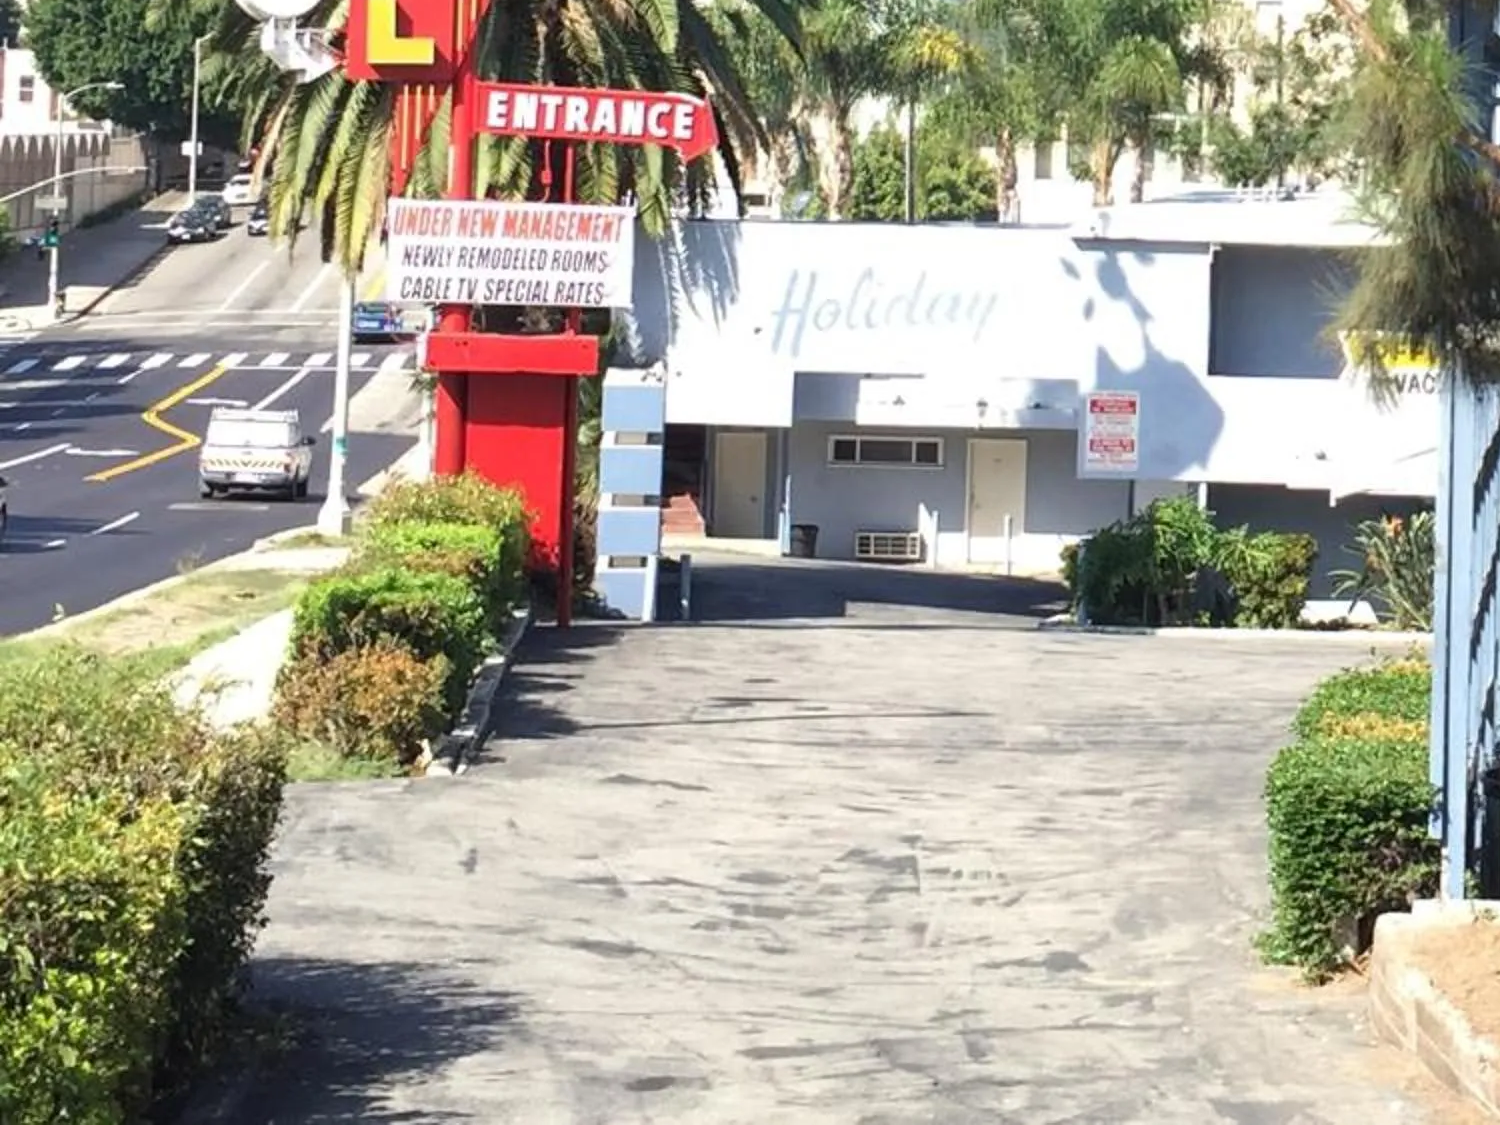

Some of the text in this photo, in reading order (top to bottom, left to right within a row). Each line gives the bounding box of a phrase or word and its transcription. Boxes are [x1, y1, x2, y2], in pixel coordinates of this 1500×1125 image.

[487, 92, 695, 140] ENTRANCE
[393, 206, 626, 244] UNDER NEW MANAGEMENT
[402, 244, 609, 274] NEWLY REMODELED ROOMS
[400, 275, 452, 300] CABLE
[483, 278, 549, 304] SPECIAL
[553, 281, 605, 306] RATES
[771, 268, 998, 358] Holiday
